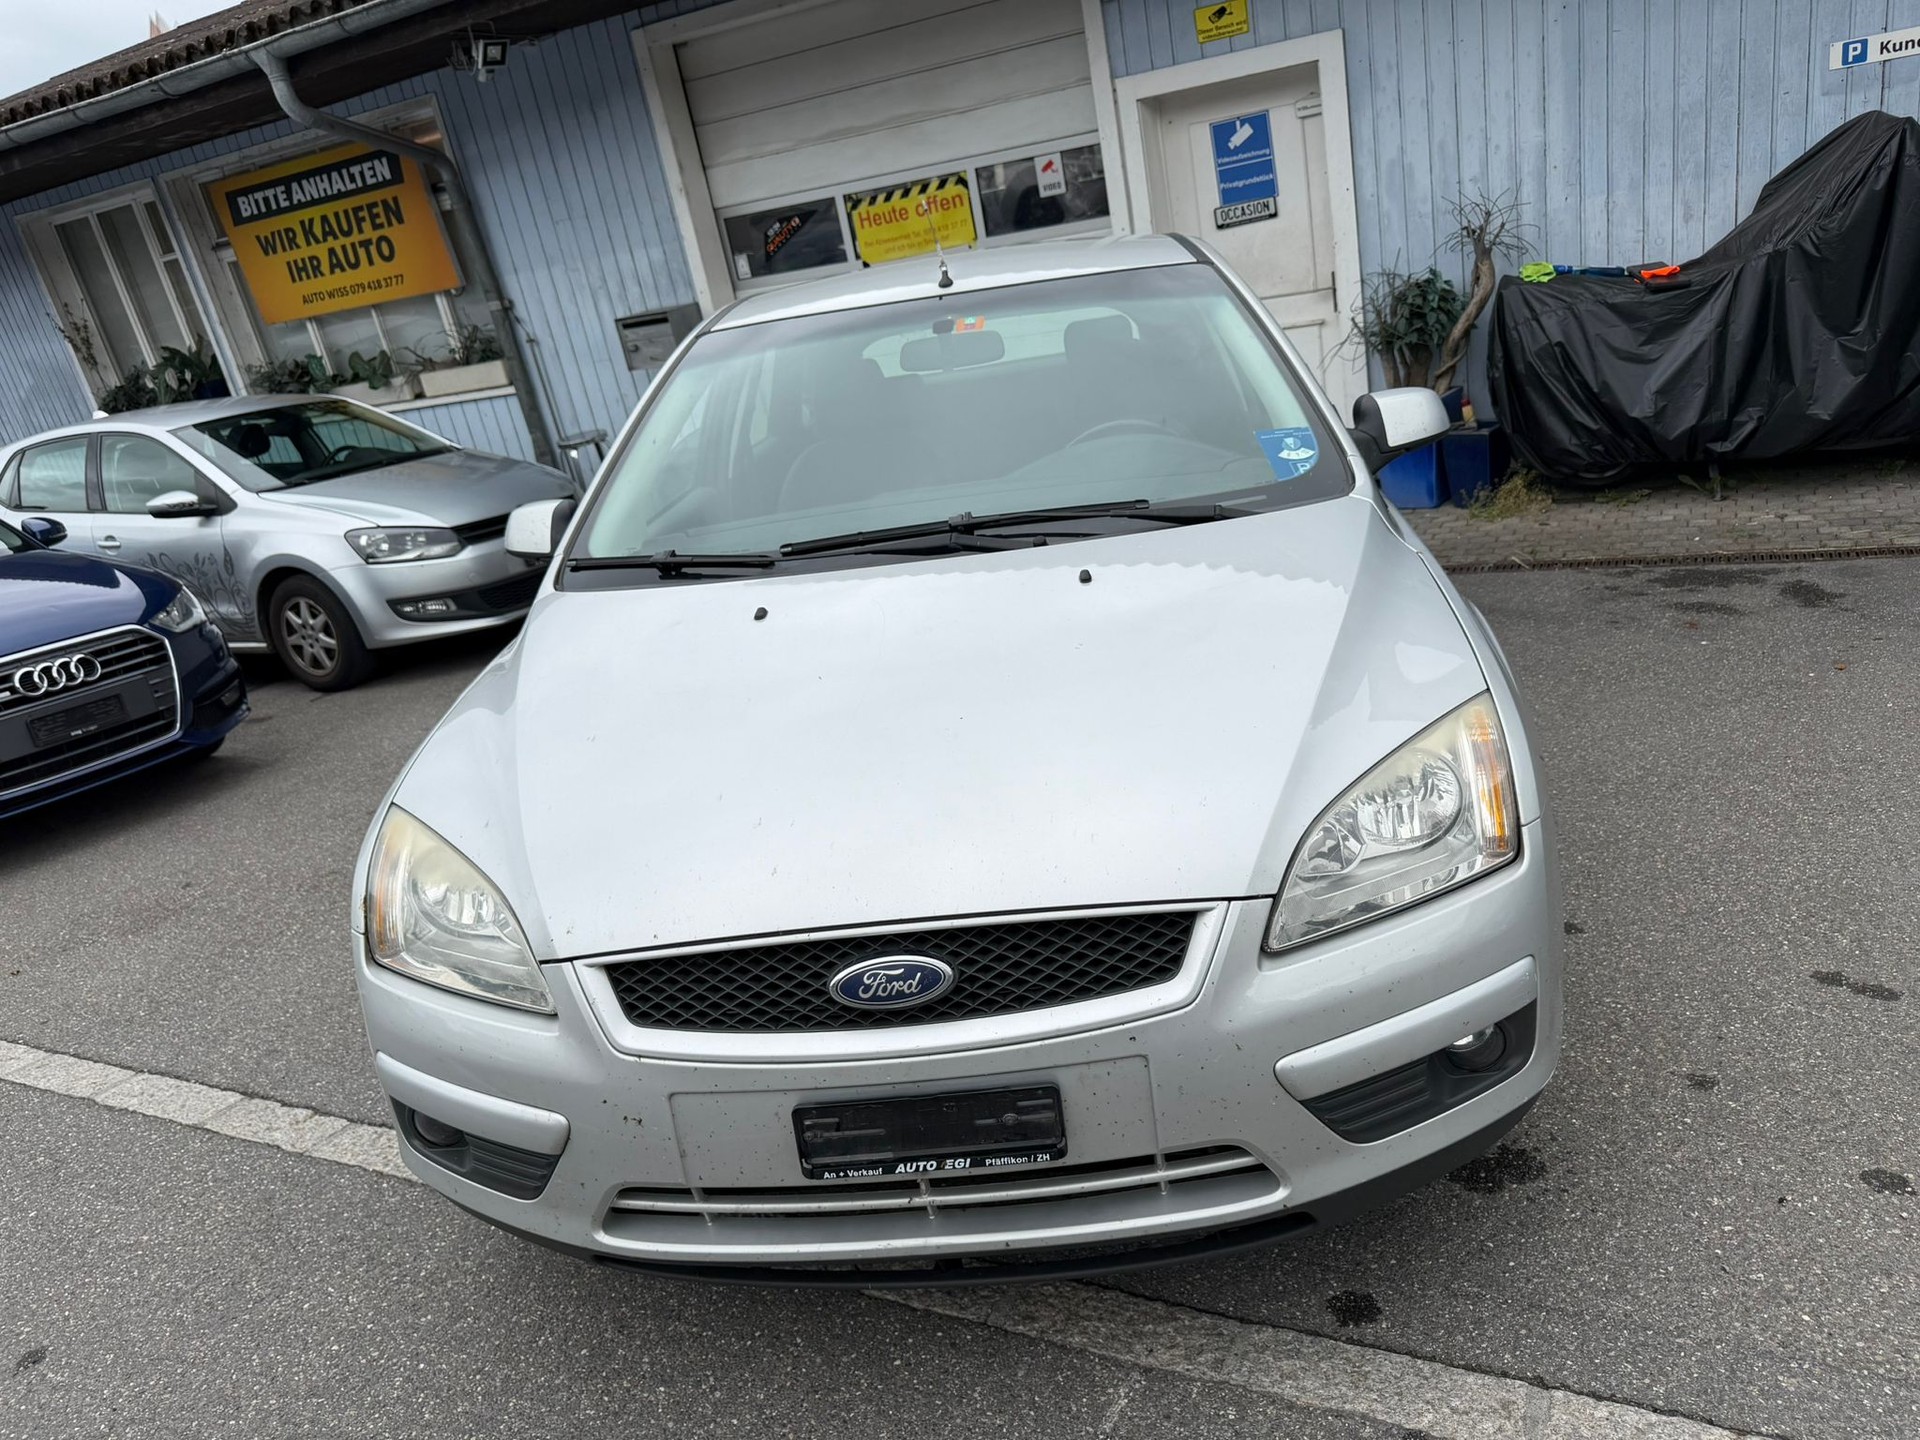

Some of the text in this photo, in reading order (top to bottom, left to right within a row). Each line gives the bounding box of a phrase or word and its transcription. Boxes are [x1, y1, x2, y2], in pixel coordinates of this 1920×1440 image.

[1848, 43, 1862, 62] P
[237, 156, 392, 219] BITTE ANHALTEN
[1042, 181, 1062, 192] VIDEO
[858, 194, 964, 230] Heute offen
[1220, 200, 1270, 222] OCCASION
[255, 196, 405, 257] WIR KAUFEN
[286, 235, 396, 284] IHR AUTO
[302, 291, 325, 305] AUTO
[326, 286, 349, 300] WISS
[350, 282, 366, 295] 079
[858, 968, 921, 999] Ford
[823, 1171, 836, 1180] An
[847, 1167, 883, 1178] Verkauf
[895, 1160, 936, 1174] AUTO
[1036, 1153, 1050, 1162] ZH
